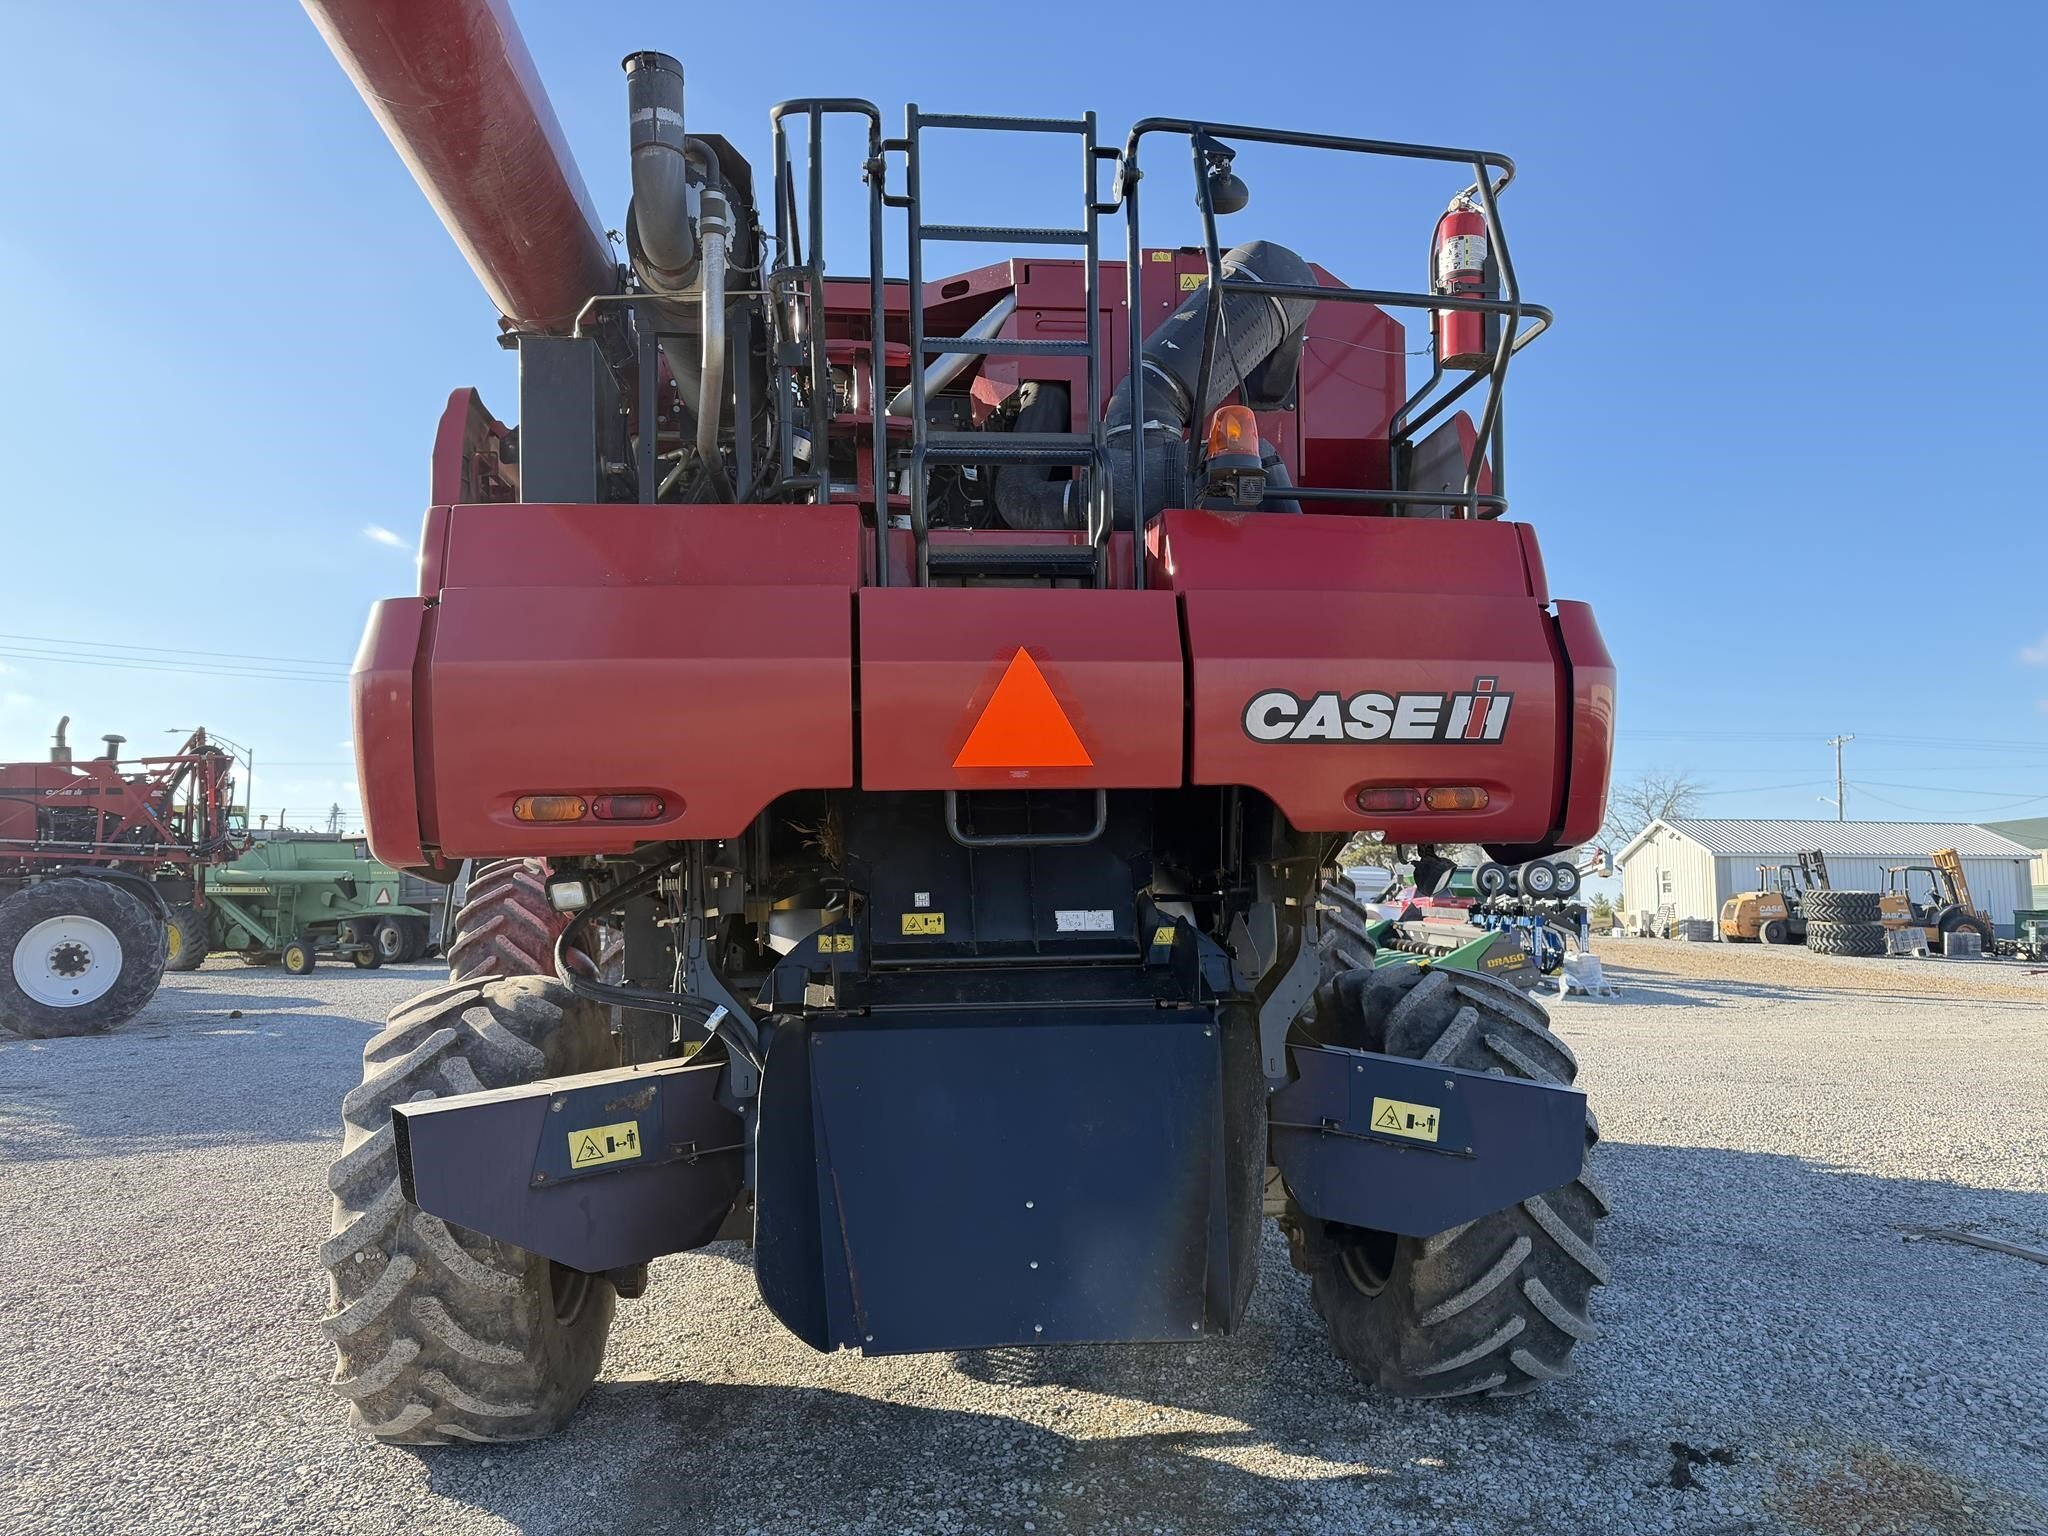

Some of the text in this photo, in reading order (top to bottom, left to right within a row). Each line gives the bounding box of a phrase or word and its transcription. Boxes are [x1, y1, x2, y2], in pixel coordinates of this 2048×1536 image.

[1244, 691, 1444, 741] CASE
[1759, 904, 1784, 912] CASE
[1486, 952, 1526, 968] DRAGO
